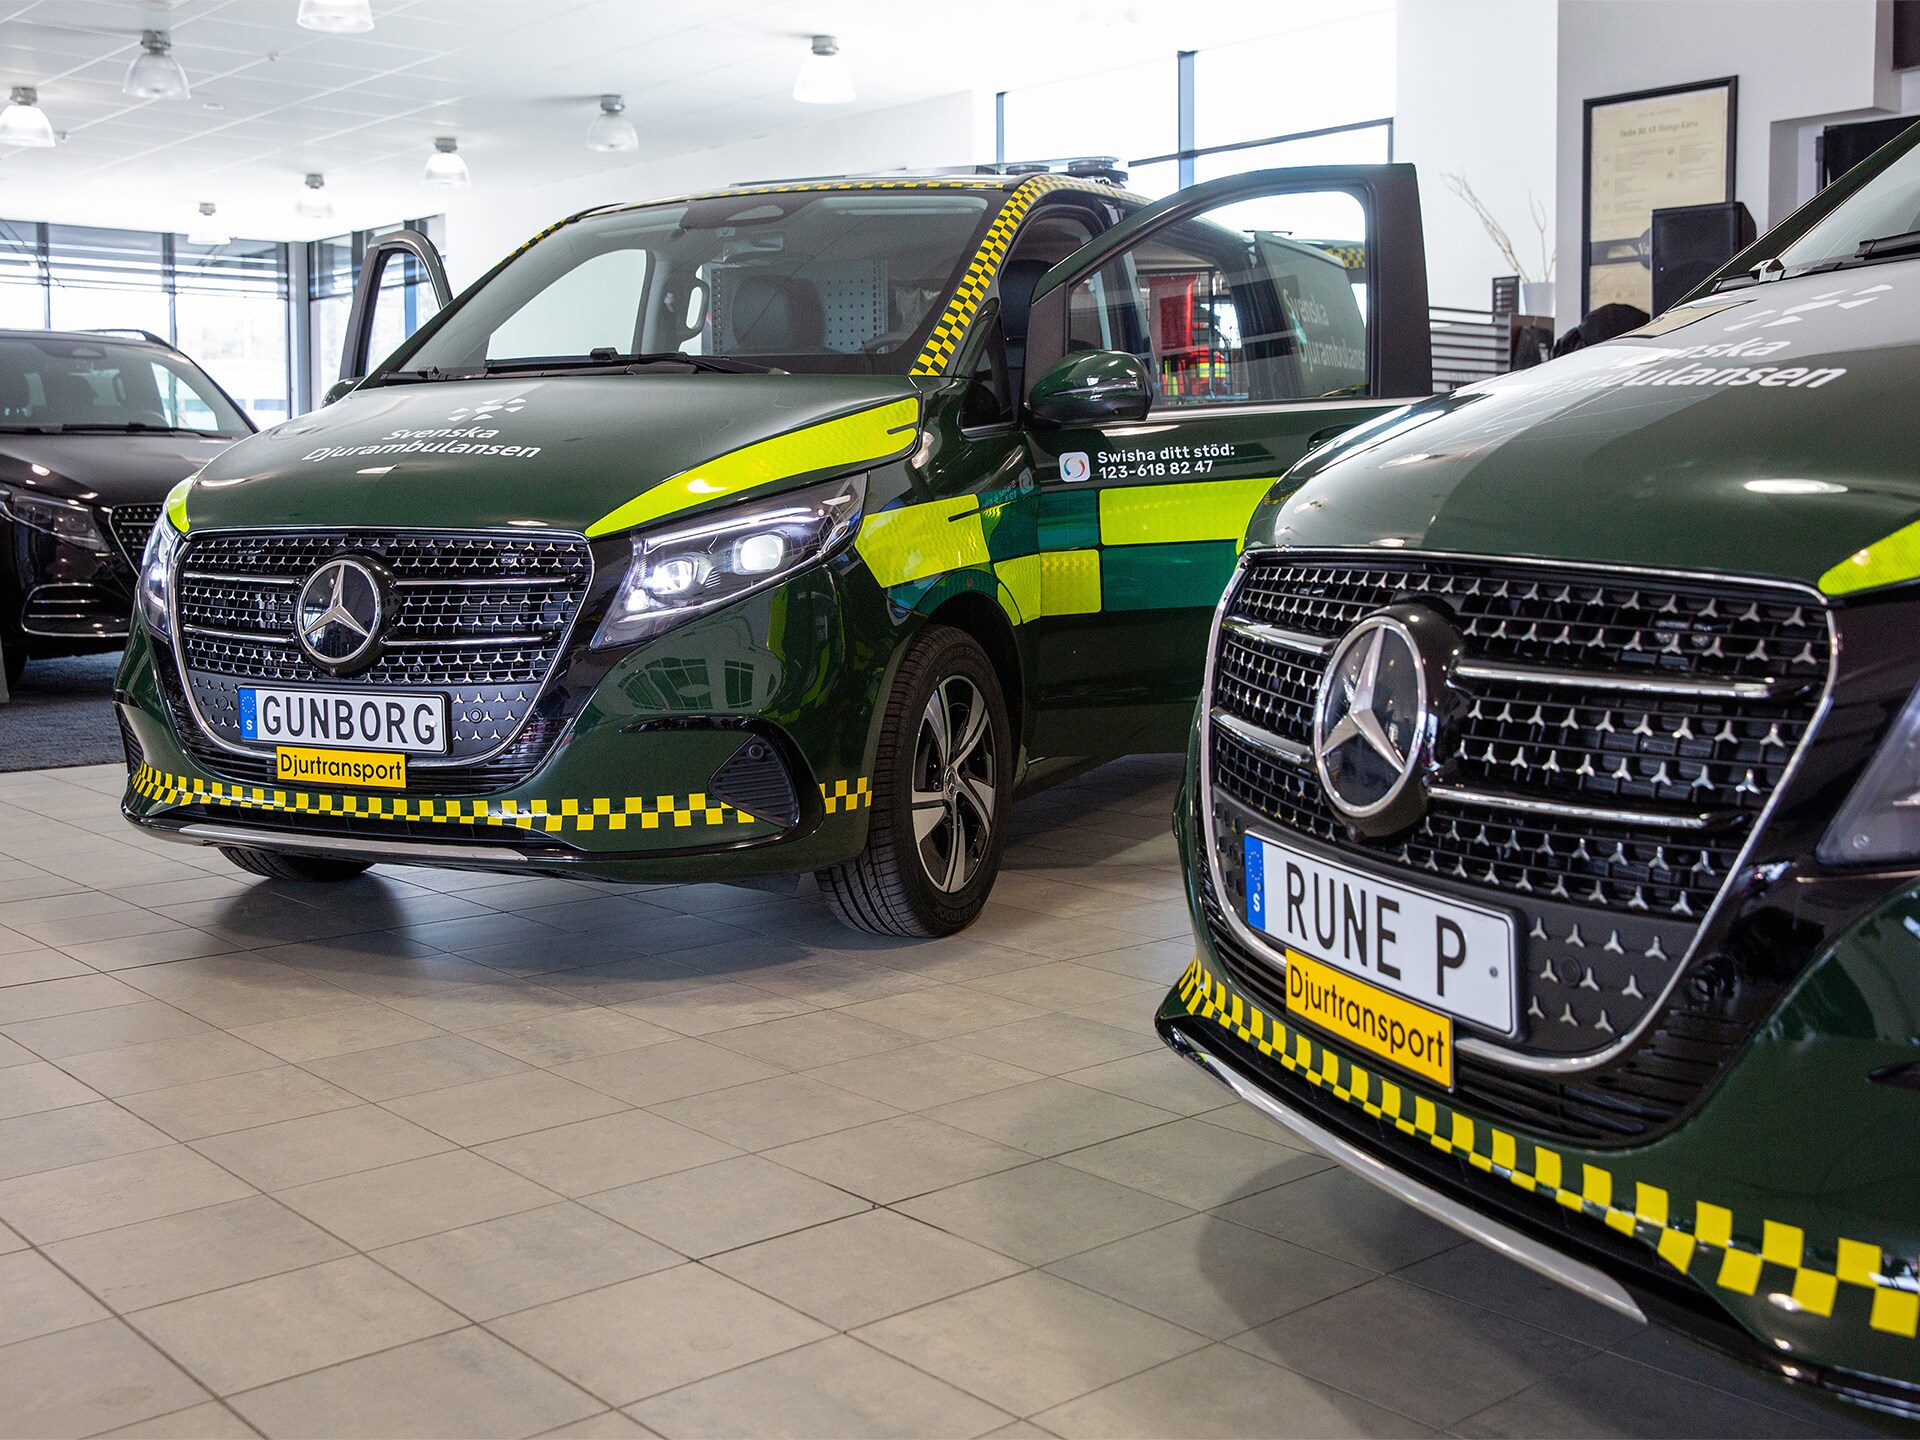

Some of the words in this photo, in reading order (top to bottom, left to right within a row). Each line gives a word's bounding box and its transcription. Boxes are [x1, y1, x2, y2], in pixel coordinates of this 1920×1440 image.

[382, 425, 500, 441] Svenska
[301, 439, 542, 463] Djurambulansen
[1097, 450, 1156, 463] Swisha
[1160, 446, 1190, 460] ditt
[1194, 443, 1236, 458] stöd:
[1098, 461, 1166, 480] 123-618
[1170, 460, 1192, 475] 82
[1195, 459, 1214, 474] 47
[246, 719, 253, 731] S
[262, 695, 436, 745] GUNBORG
[280, 753, 402, 782] Djurtransport
[1252, 892, 1261, 912] S
[1286, 861, 1401, 981] RUNE
[1436, 915, 1466, 997] P
[1290, 964, 1445, 1068] Djurtransport
